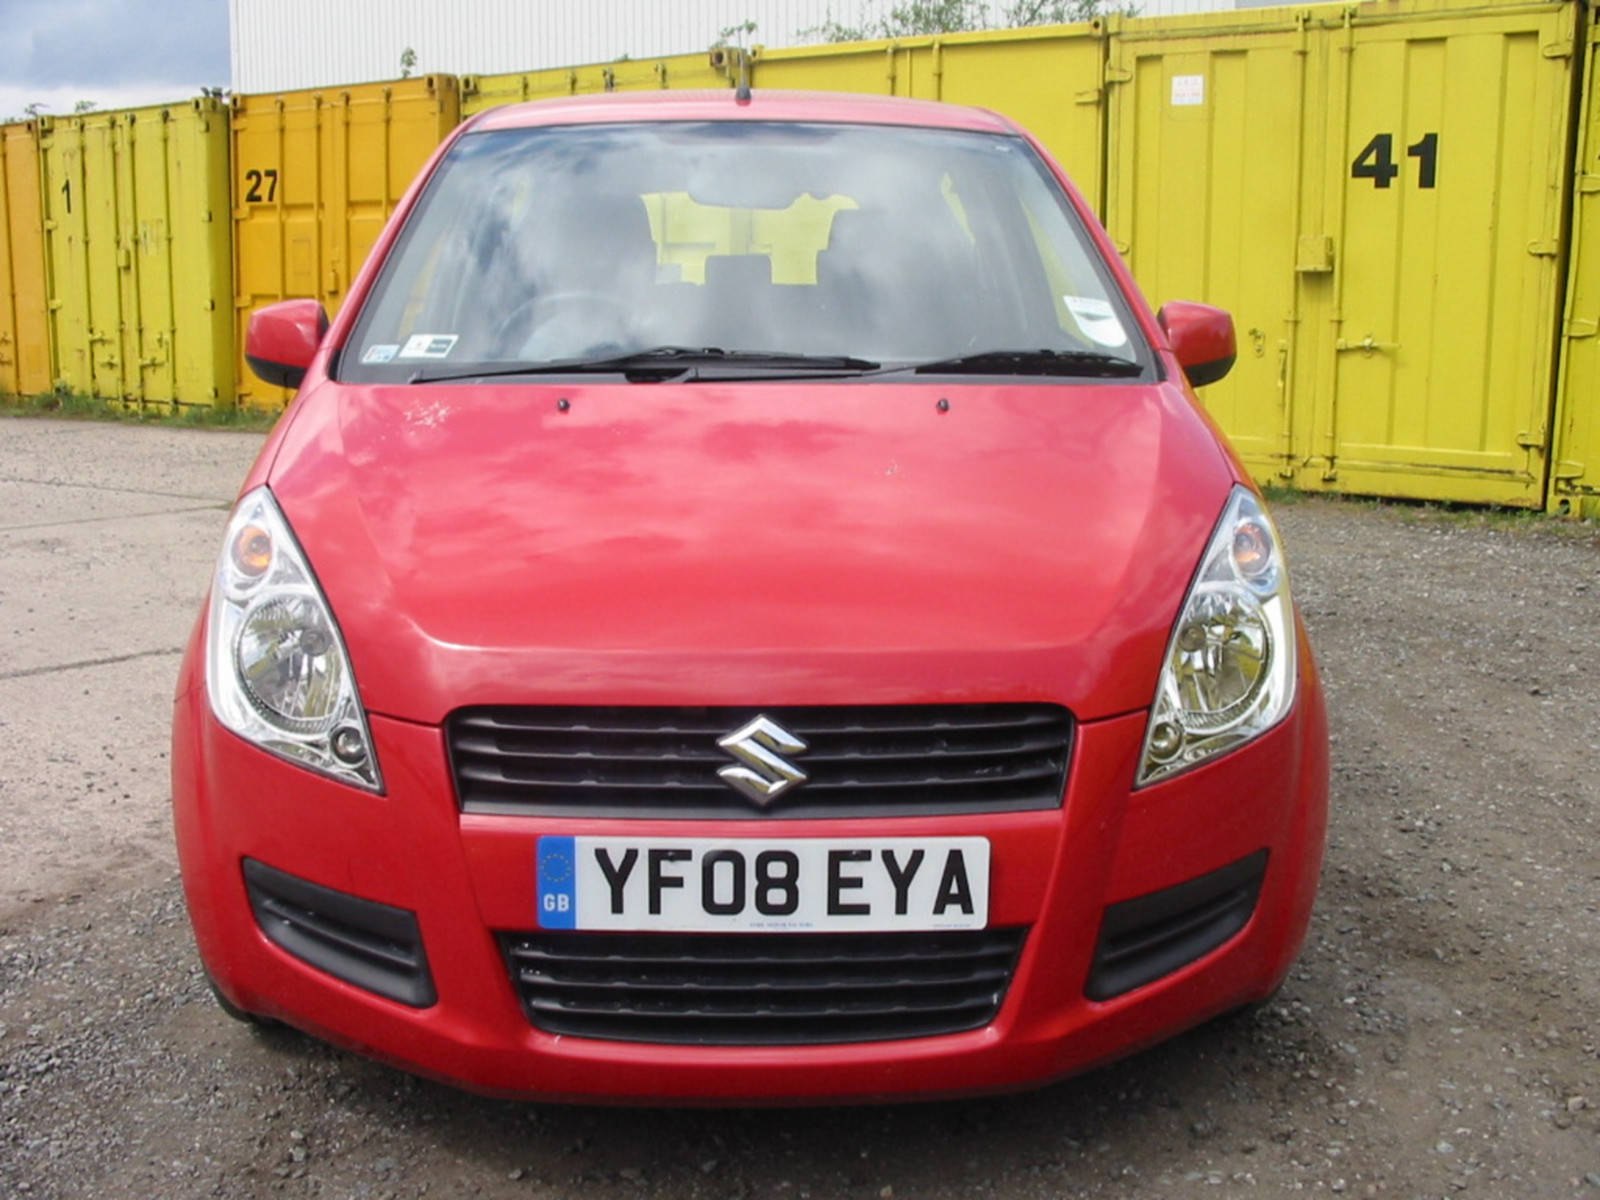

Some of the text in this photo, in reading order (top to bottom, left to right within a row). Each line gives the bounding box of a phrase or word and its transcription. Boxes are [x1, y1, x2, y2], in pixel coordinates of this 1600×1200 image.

[1351, 132, 1438, 189] 41
[61, 179, 71, 214] 1
[245, 169, 278, 203] 27
[594, 847, 975, 916] YF08 EYA
[543, 894, 570, 912] GB
